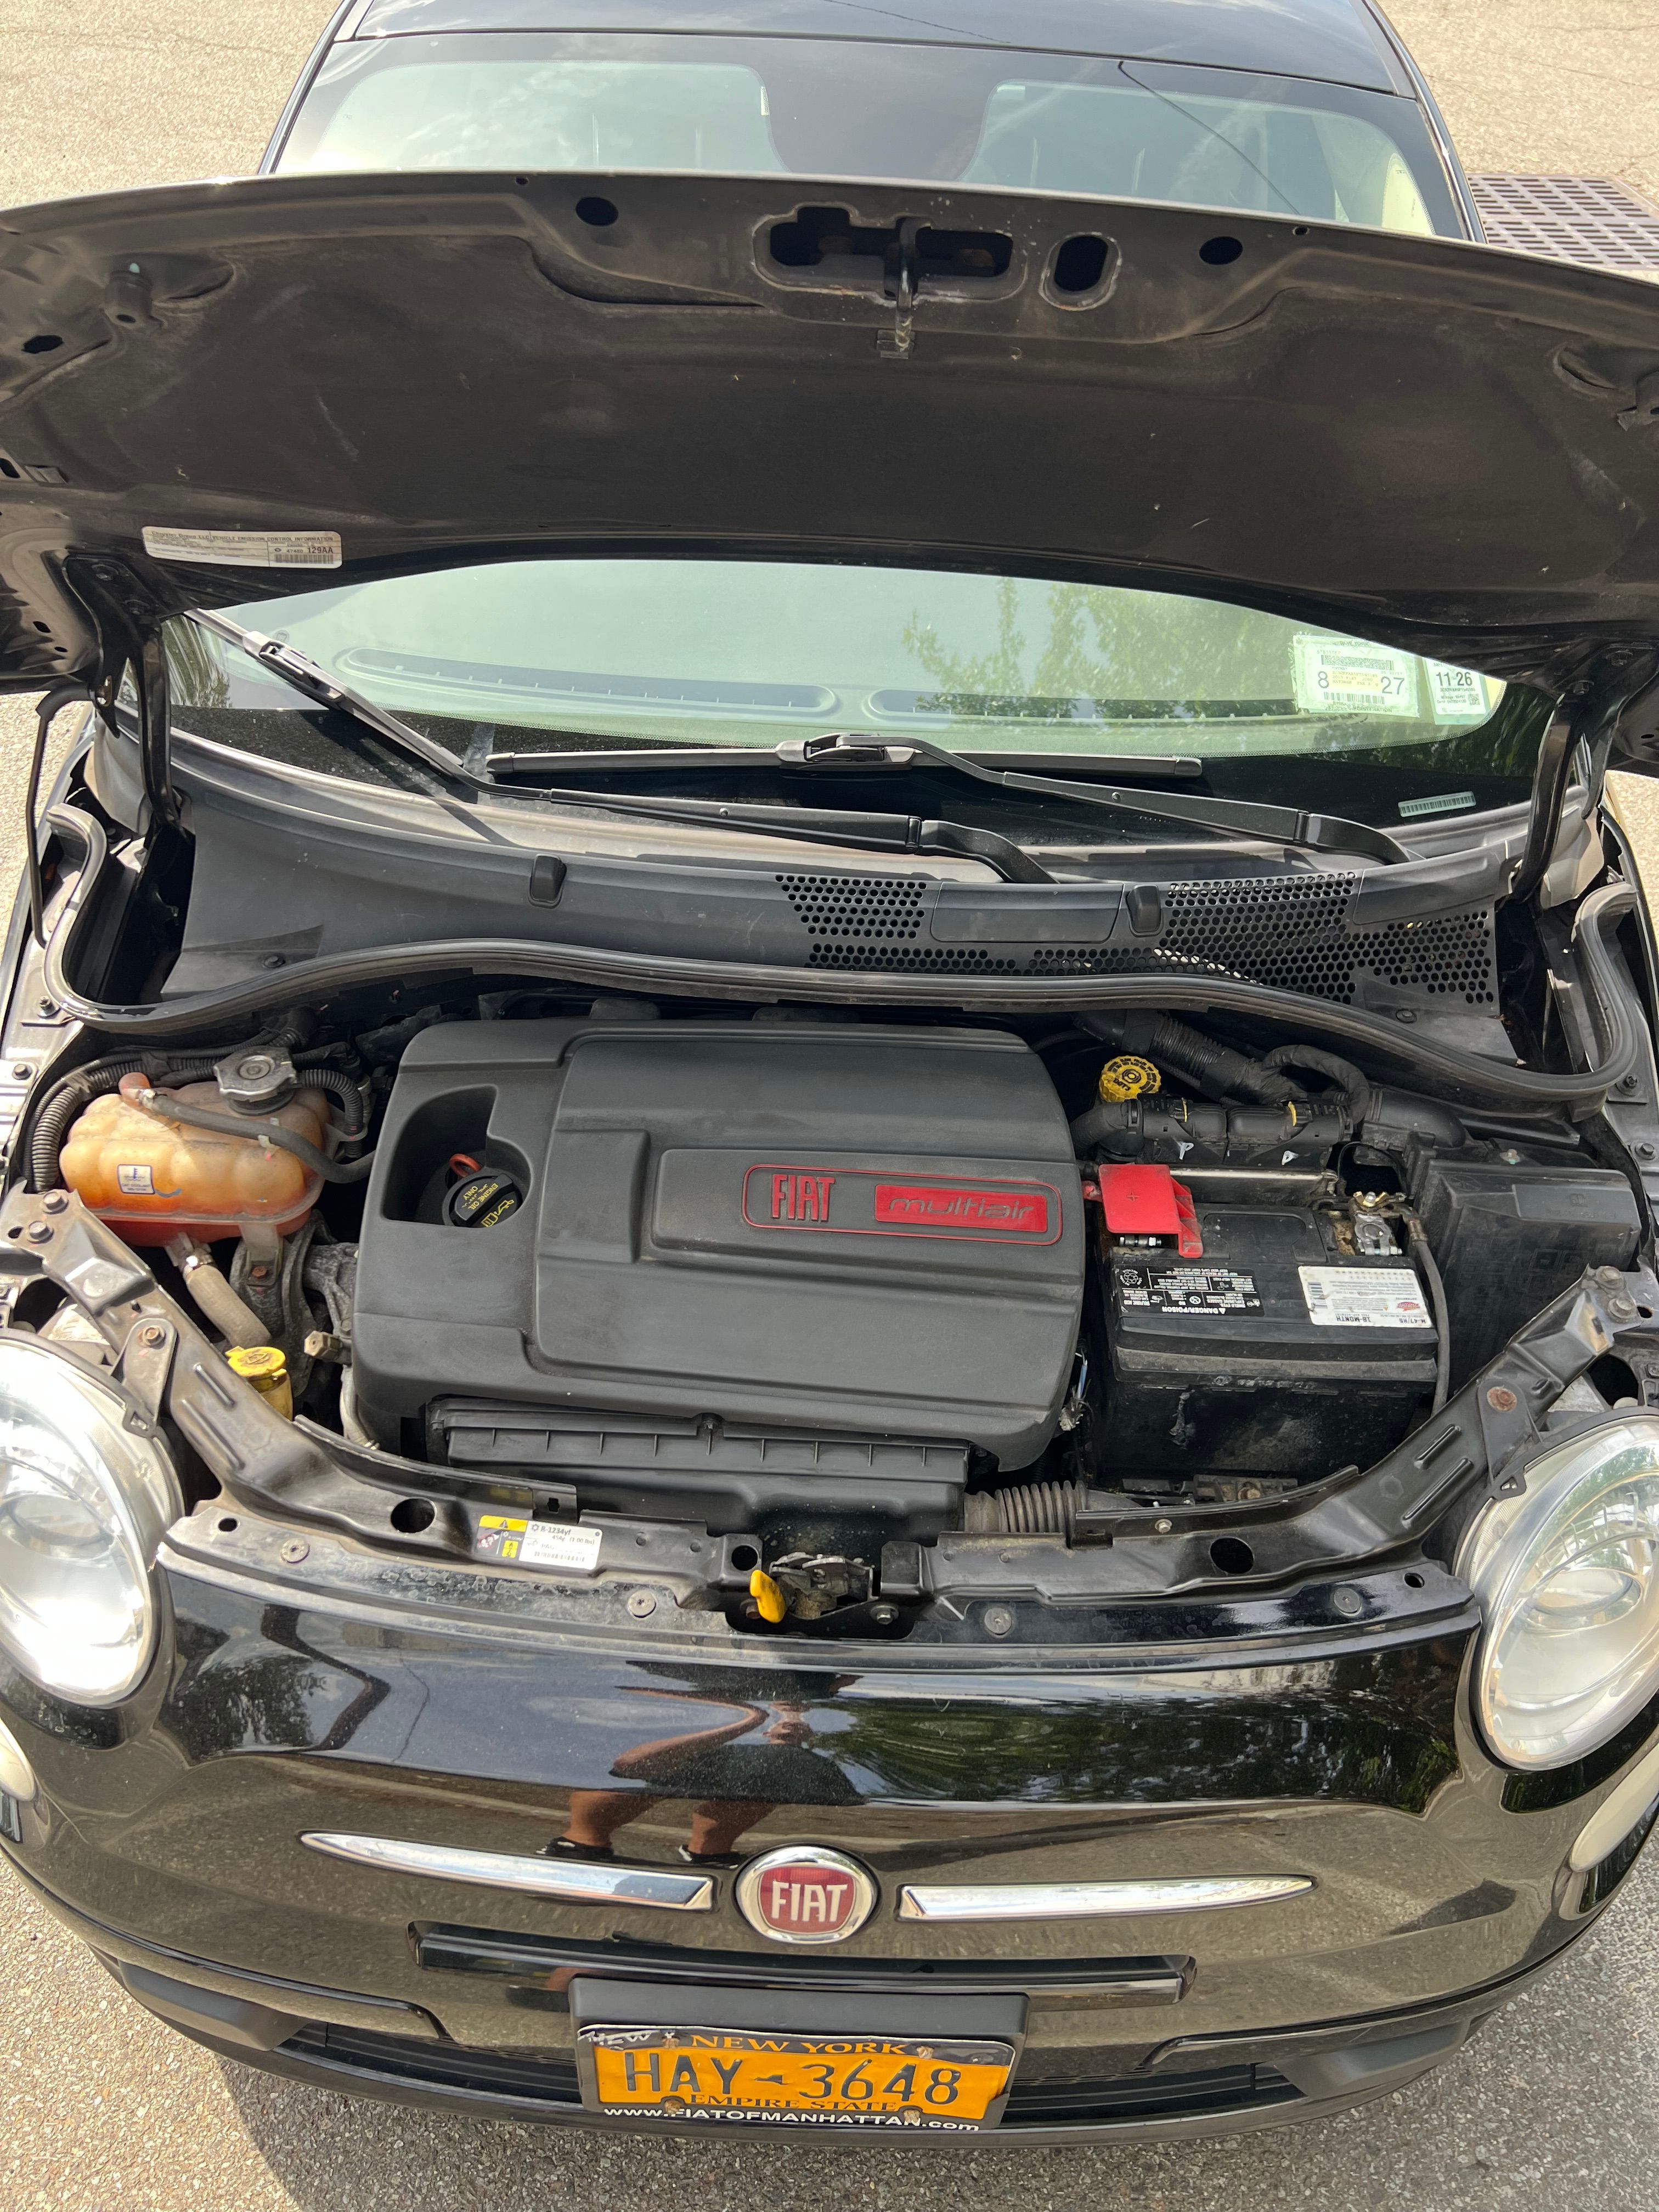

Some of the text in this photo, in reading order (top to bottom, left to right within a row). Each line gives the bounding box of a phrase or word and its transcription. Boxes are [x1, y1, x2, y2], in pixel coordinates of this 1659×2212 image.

[1318, 671, 1329, 689] 8
[1380, 676, 1405, 695] 27
[463, 1186, 478, 1200] ONLY
[477, 1183, 499, 1202] ENGINE
[771, 1173, 1036, 1223] FIAT multiair
[468, 1201, 479, 1210] OIL
[540, 1526, 572, 1536] R-1234yf
[771, 1880, 848, 1922] FIAT
[691, 2035, 790, 2052] NEW
[800, 2041, 911, 2055] YORK
[624, 2052, 961, 2105] HAY 3648
[691, 2094, 896, 2111] EMPIRE STATE
